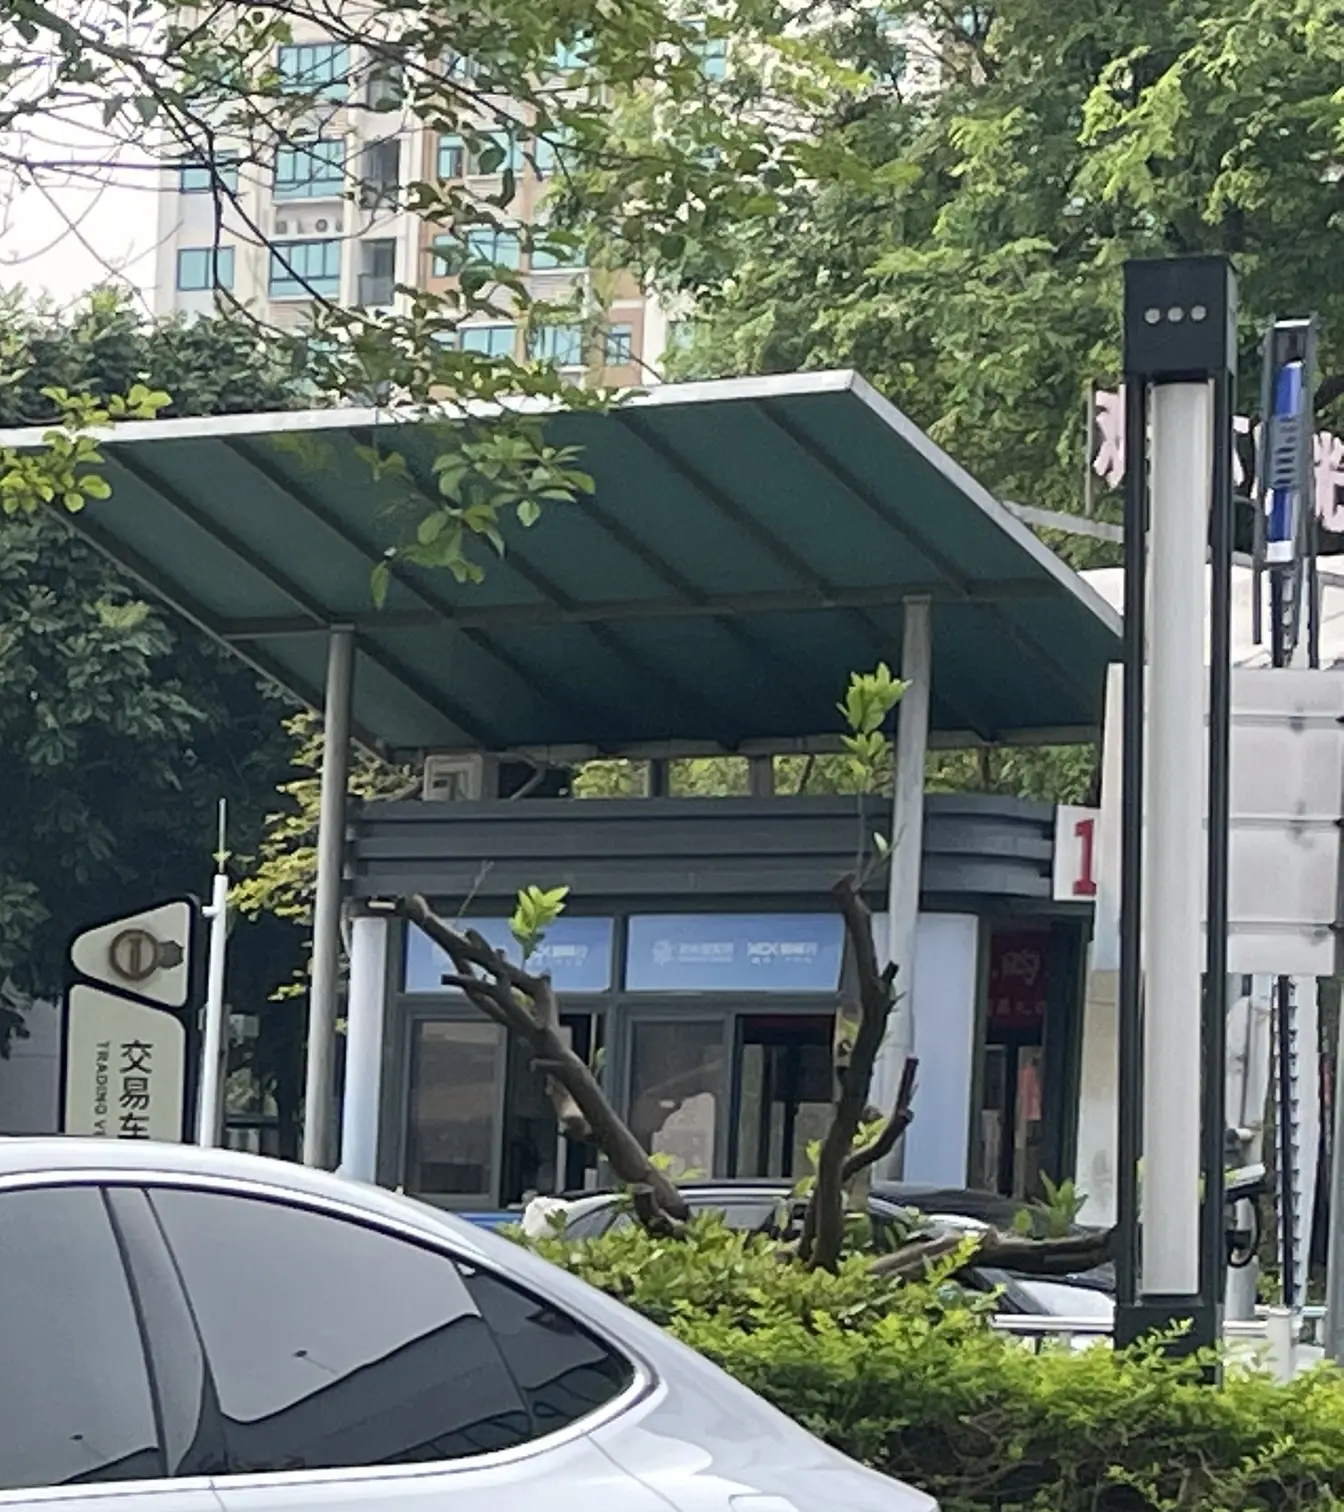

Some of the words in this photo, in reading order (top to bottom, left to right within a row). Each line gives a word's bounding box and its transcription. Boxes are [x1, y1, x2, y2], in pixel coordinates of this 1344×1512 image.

[1072, 817, 1097, 896] 1
[117, 1039, 154, 1140] 交易车
